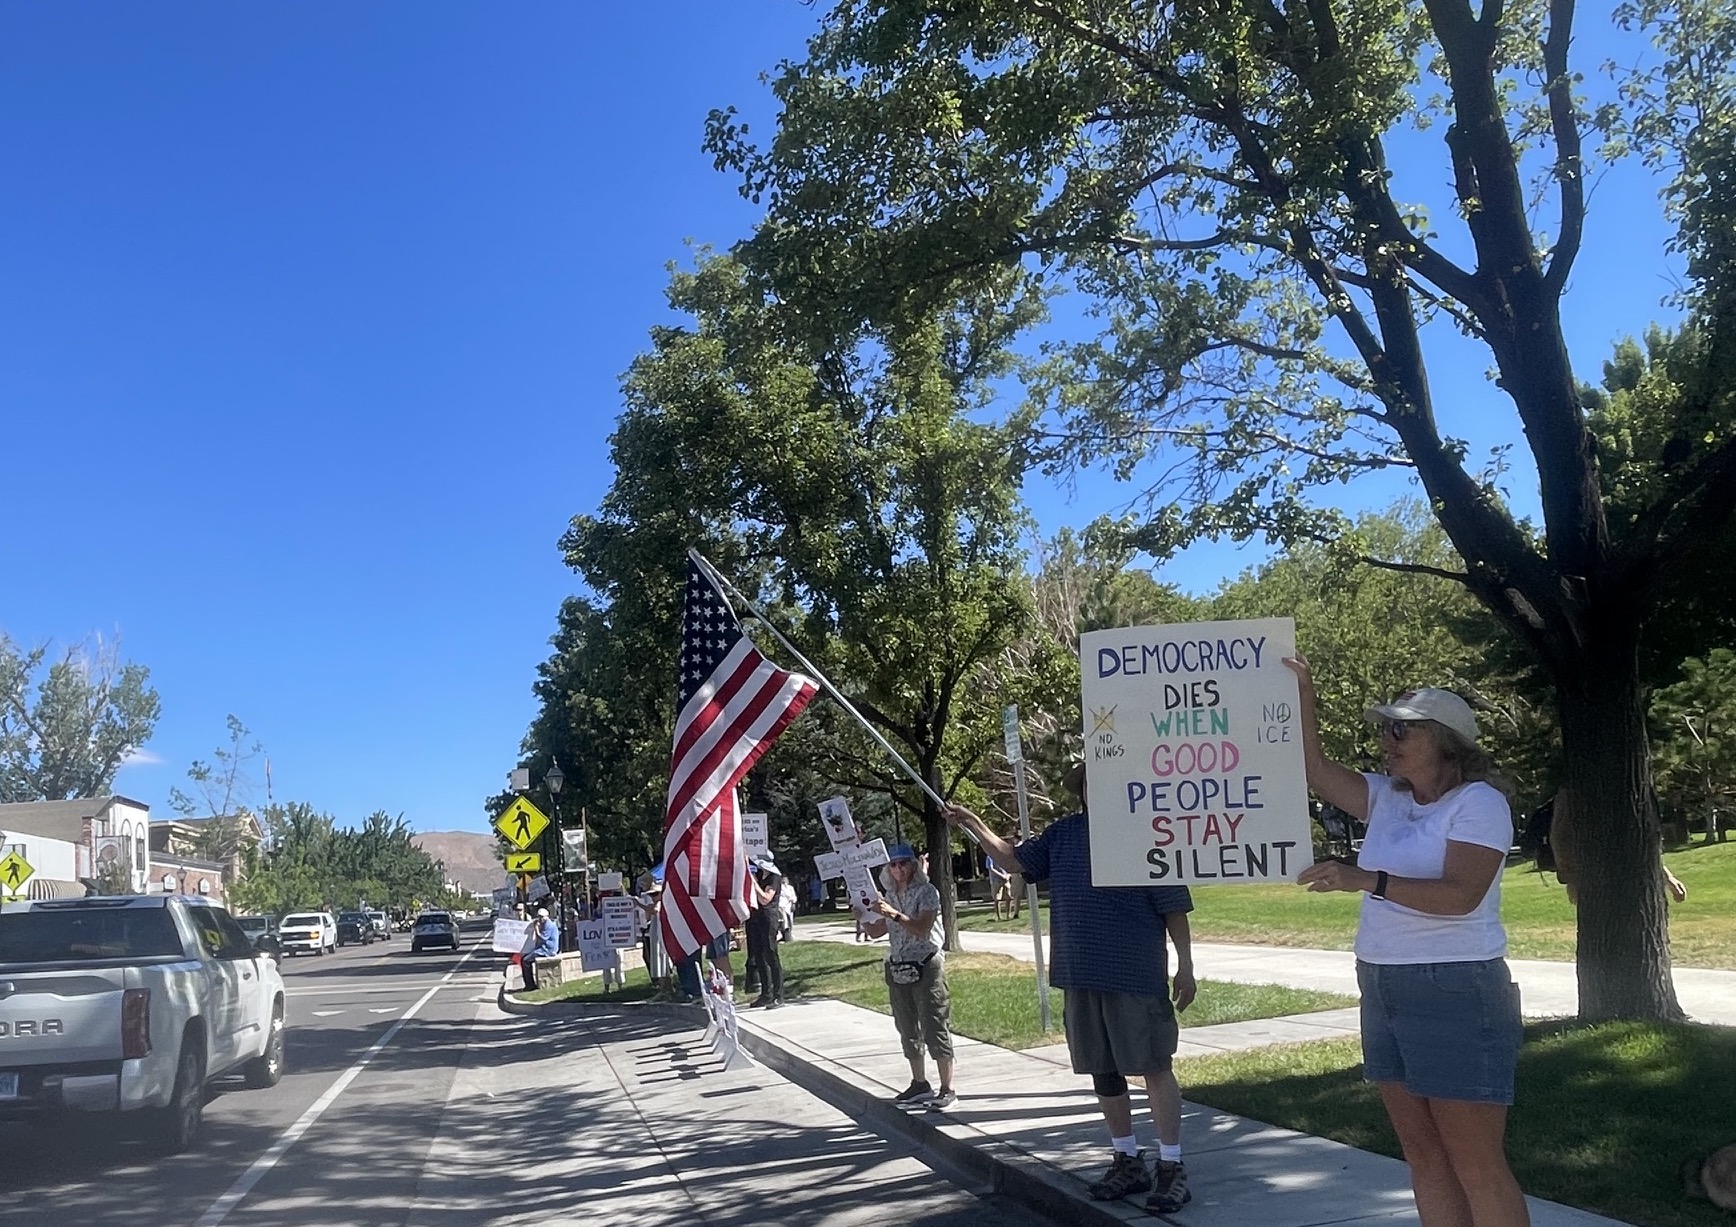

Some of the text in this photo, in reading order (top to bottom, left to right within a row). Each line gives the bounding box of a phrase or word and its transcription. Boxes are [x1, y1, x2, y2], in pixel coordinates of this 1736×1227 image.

[1098, 636, 1266, 678] DEMOCRACY
[1164, 679, 1220, 710] DIES
[1150, 708, 1229, 737] WHEN
[1262, 702, 1291, 723] NO
[1099, 733, 1113, 744] NO
[1257, 726, 1291, 743] ICE
[1094, 745, 1125, 761] KINGS
[1151, 740, 1240, 777] GOOD
[1127, 776, 1264, 813] PEOPLE
[744, 838, 764, 847] tapo
[1152, 813, 1245, 847] STAY
[1146, 841, 1297, 880] SILENT
[583, 928, 603, 941] LOV
